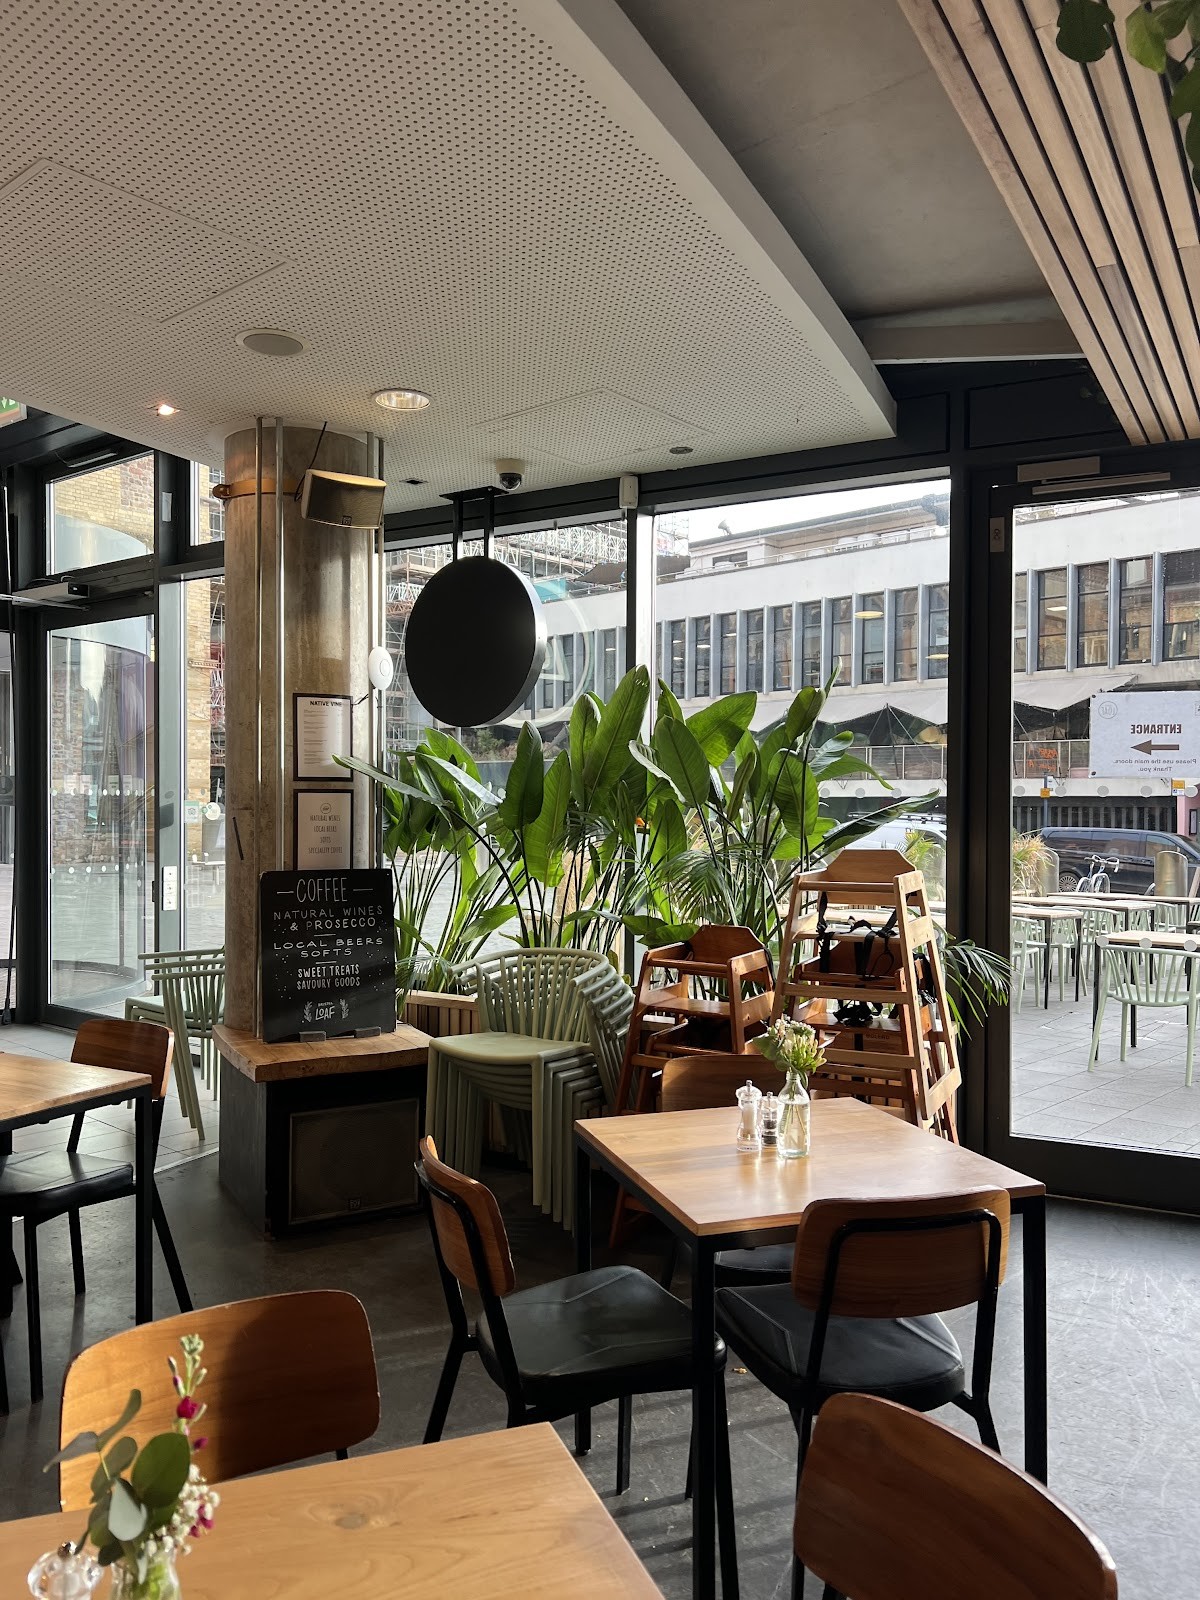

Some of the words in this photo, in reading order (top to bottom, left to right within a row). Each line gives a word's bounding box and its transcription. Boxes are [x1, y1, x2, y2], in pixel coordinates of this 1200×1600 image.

[296, 877, 348, 903] COFFEE
[273, 907, 335, 921] NATURAL
[342, 905, 383, 917] WINES
[290, 922, 298, 931] &
[306, 917, 376, 931] PROSECCO
[273, 939, 328, 950] LOCAL
[336, 938, 383, 947] BEERS
[300, 948, 352, 958] SOFTS
[297, 967, 326, 978] SWEET
[330, 964, 360, 976] TREATS
[297, 979, 331, 990] SAVOURY
[334, 976, 361, 988] GOODS
[315, 1006, 335, 1021] LOAF
